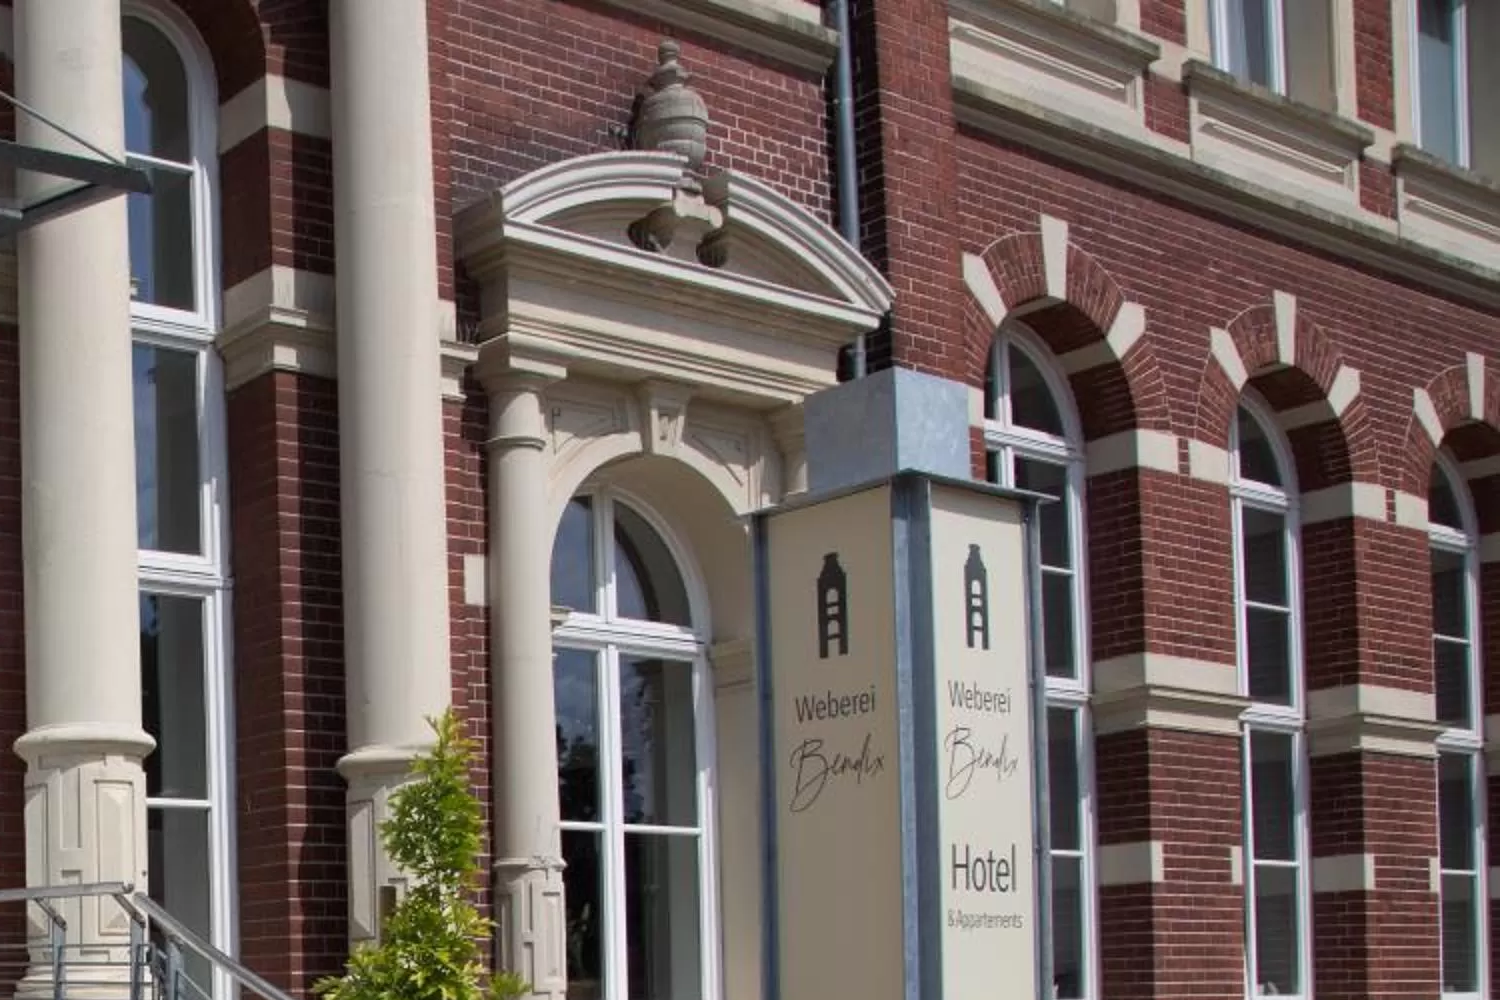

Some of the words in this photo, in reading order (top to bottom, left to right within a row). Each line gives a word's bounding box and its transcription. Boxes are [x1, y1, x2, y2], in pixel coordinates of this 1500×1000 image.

[795, 684, 875, 723] Weberei
[947, 680, 1011, 713] Weberei
[789, 732, 885, 812] Bendix
[943, 725, 1018, 800] Bendix
[951, 844, 1017, 892] Hotel
